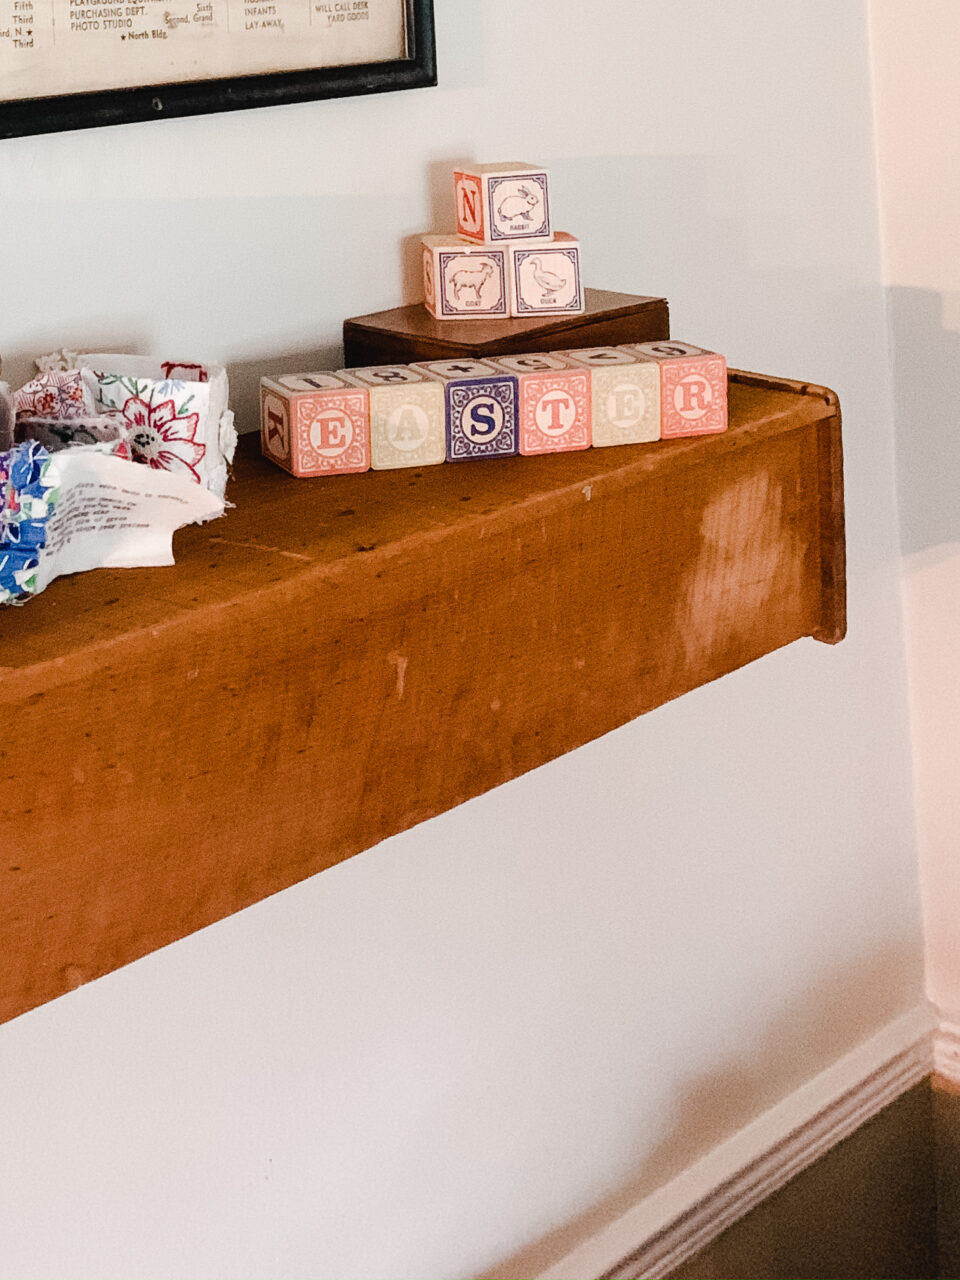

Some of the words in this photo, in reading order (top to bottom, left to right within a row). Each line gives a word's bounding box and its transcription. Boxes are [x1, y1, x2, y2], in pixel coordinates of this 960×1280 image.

[70, 20, 99, 31] PHOTO
[102, 17, 132, 29] STUDIO
[127, 30, 149, 40] North
[151, 29, 168, 39] Bldg.
[12, 37, 33, 47] Third
[461, 187, 476, 224] N
